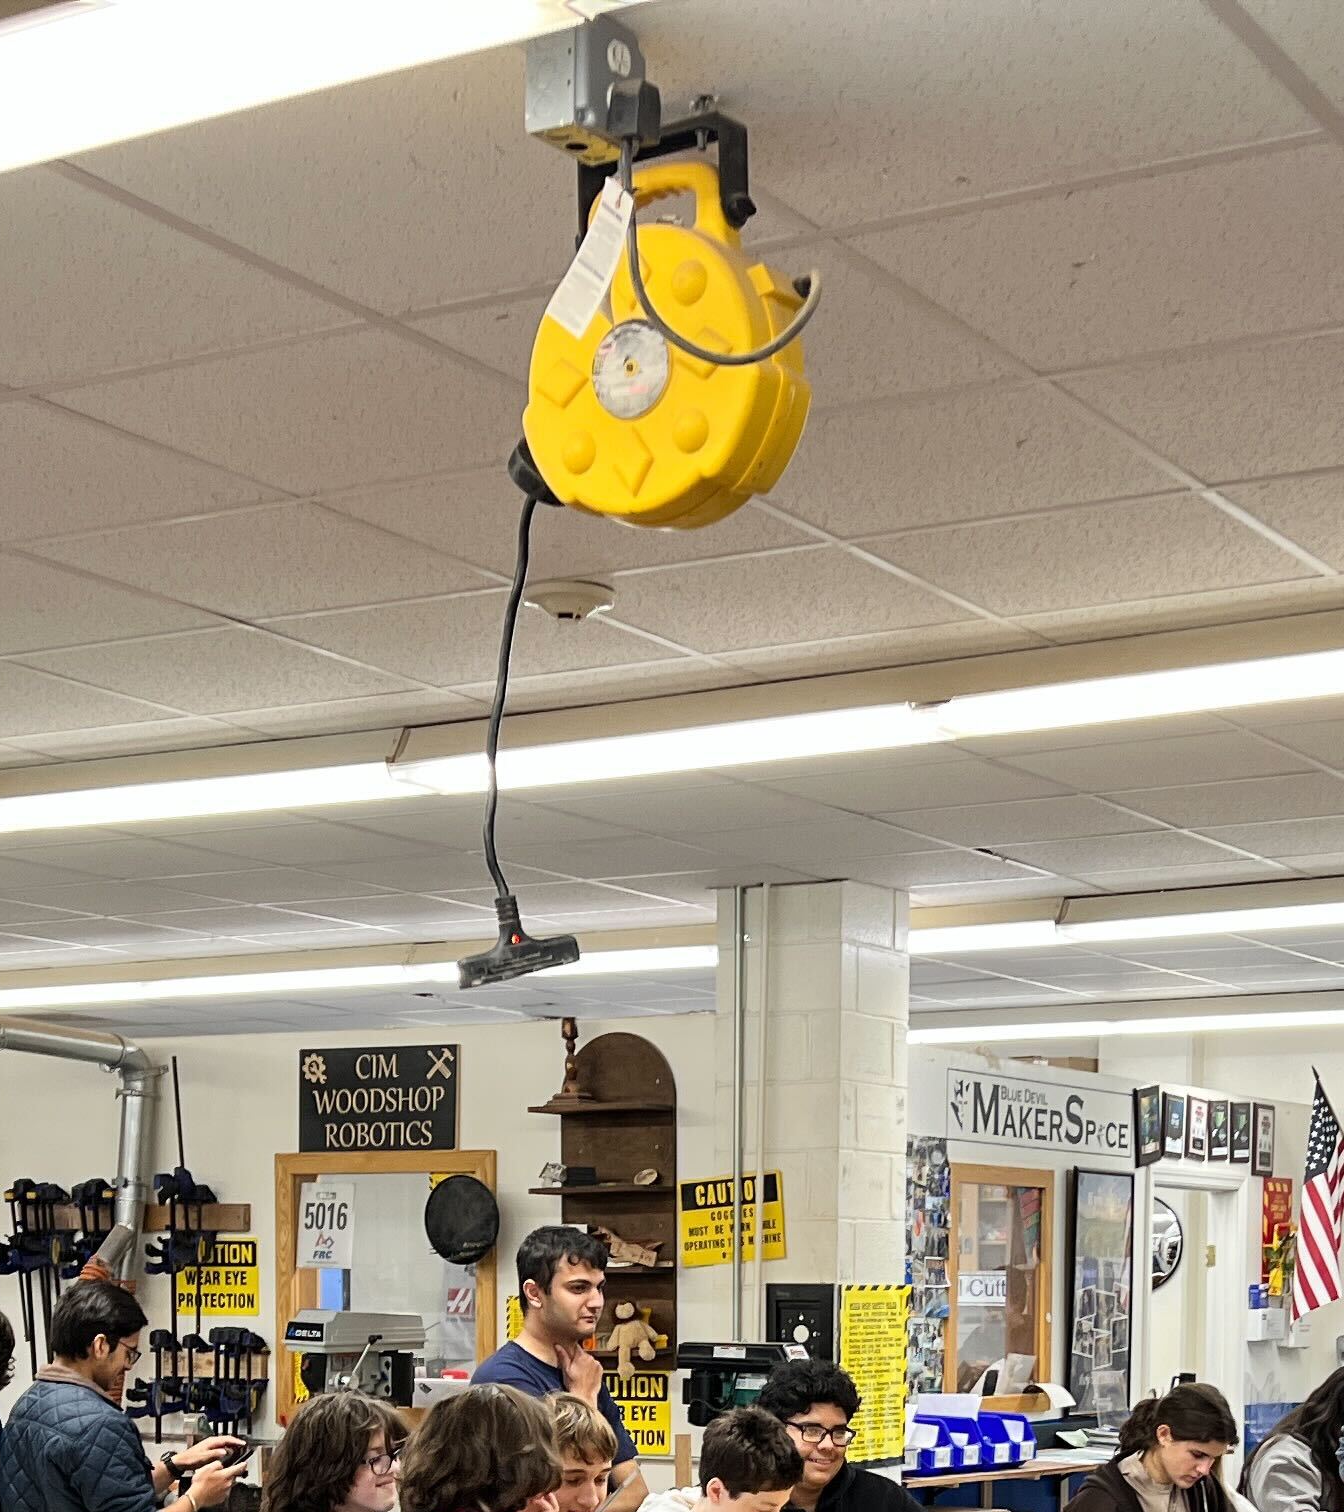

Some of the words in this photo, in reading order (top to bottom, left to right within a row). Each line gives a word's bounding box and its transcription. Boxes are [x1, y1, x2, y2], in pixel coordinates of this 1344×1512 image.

[356, 1053, 399, 1080] CIM
[312, 1086, 445, 1115] WOODSHOP
[1000, 1085, 1022, 1101] BLUE
[1024, 1088, 1048, 1105] DEVIL
[972, 1081, 1128, 1149] MAKERSPCE
[324, 1120, 433, 1148] ROBOTICS
[695, 1179, 756, 1206] CAUTO
[304, 1202, 348, 1230] 5016
[710, 1208, 754, 1221] GOGGES
[688, 1225, 709, 1237] MUST
[714, 1224, 724, 1235] BE
[729, 1222, 751, 1234] WRN
[684, 1239, 725, 1251] OPERATING
[727, 1237, 745, 1247] TS
[748, 1232, 782, 1246] MHINE
[198, 1243, 253, 1264] UTION
[313, 1250, 333, 1259] FRC
[225, 1270, 248, 1286] EYE
[295, 1329, 321, 1338] DELTA
[606, 1375, 664, 1399] UTION
[631, 1405, 657, 1422] EYE
